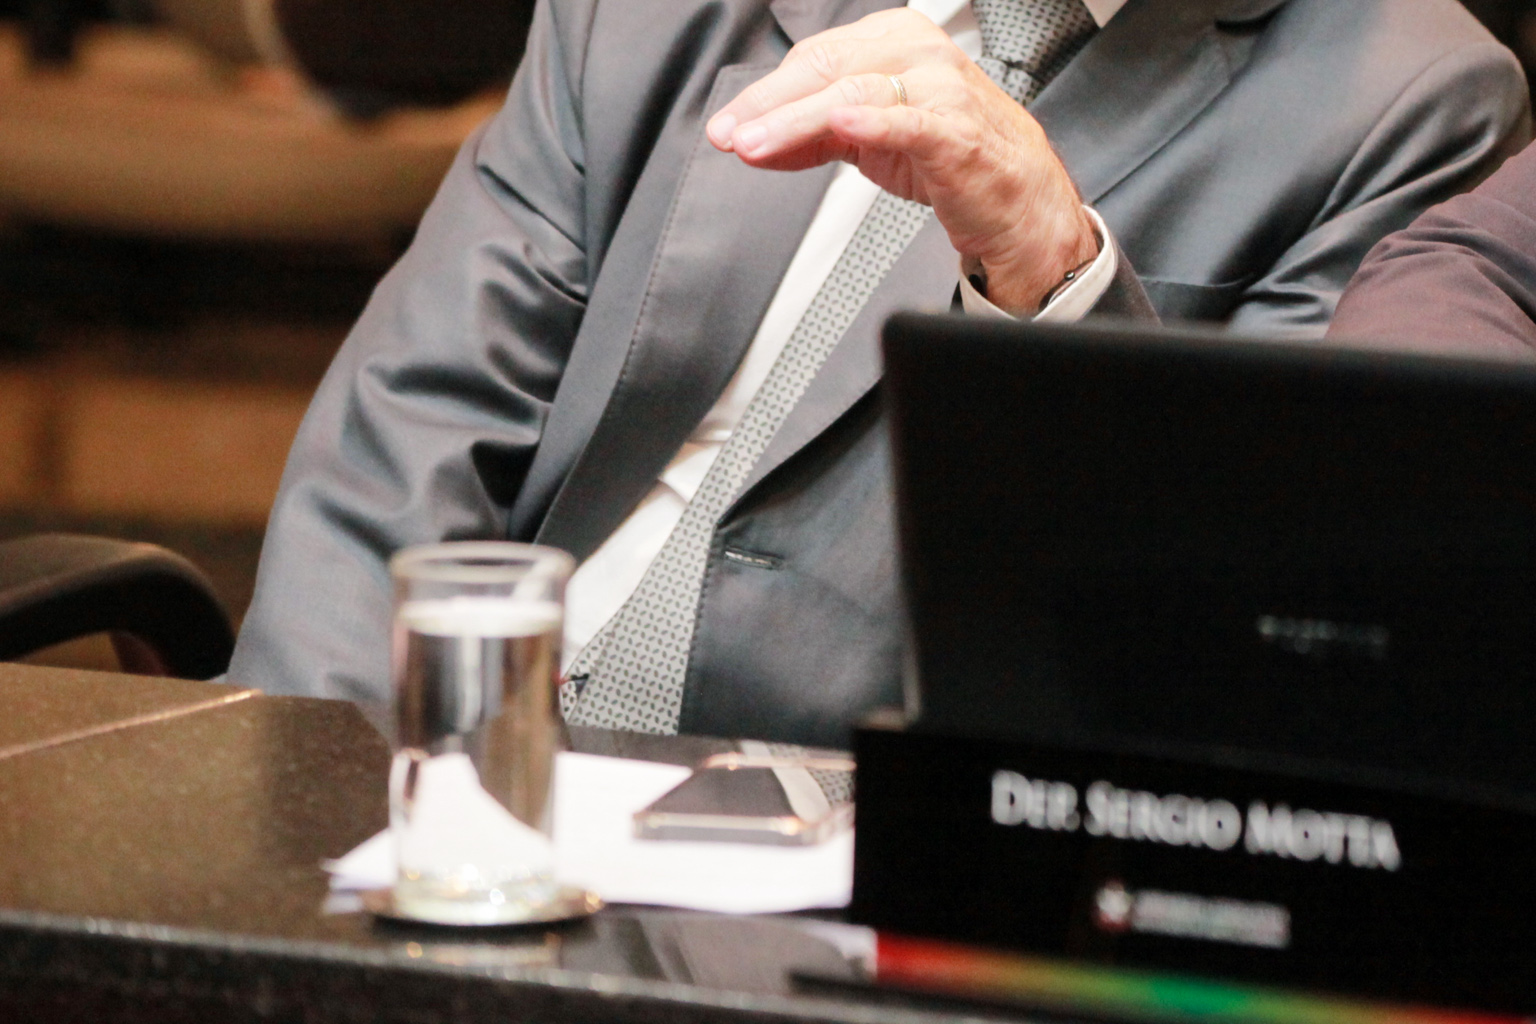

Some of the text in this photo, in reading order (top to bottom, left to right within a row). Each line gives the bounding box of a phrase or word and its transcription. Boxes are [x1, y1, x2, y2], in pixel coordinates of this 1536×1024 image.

[991, 770, 1402, 871] DEP. SERGIO MOTTA
